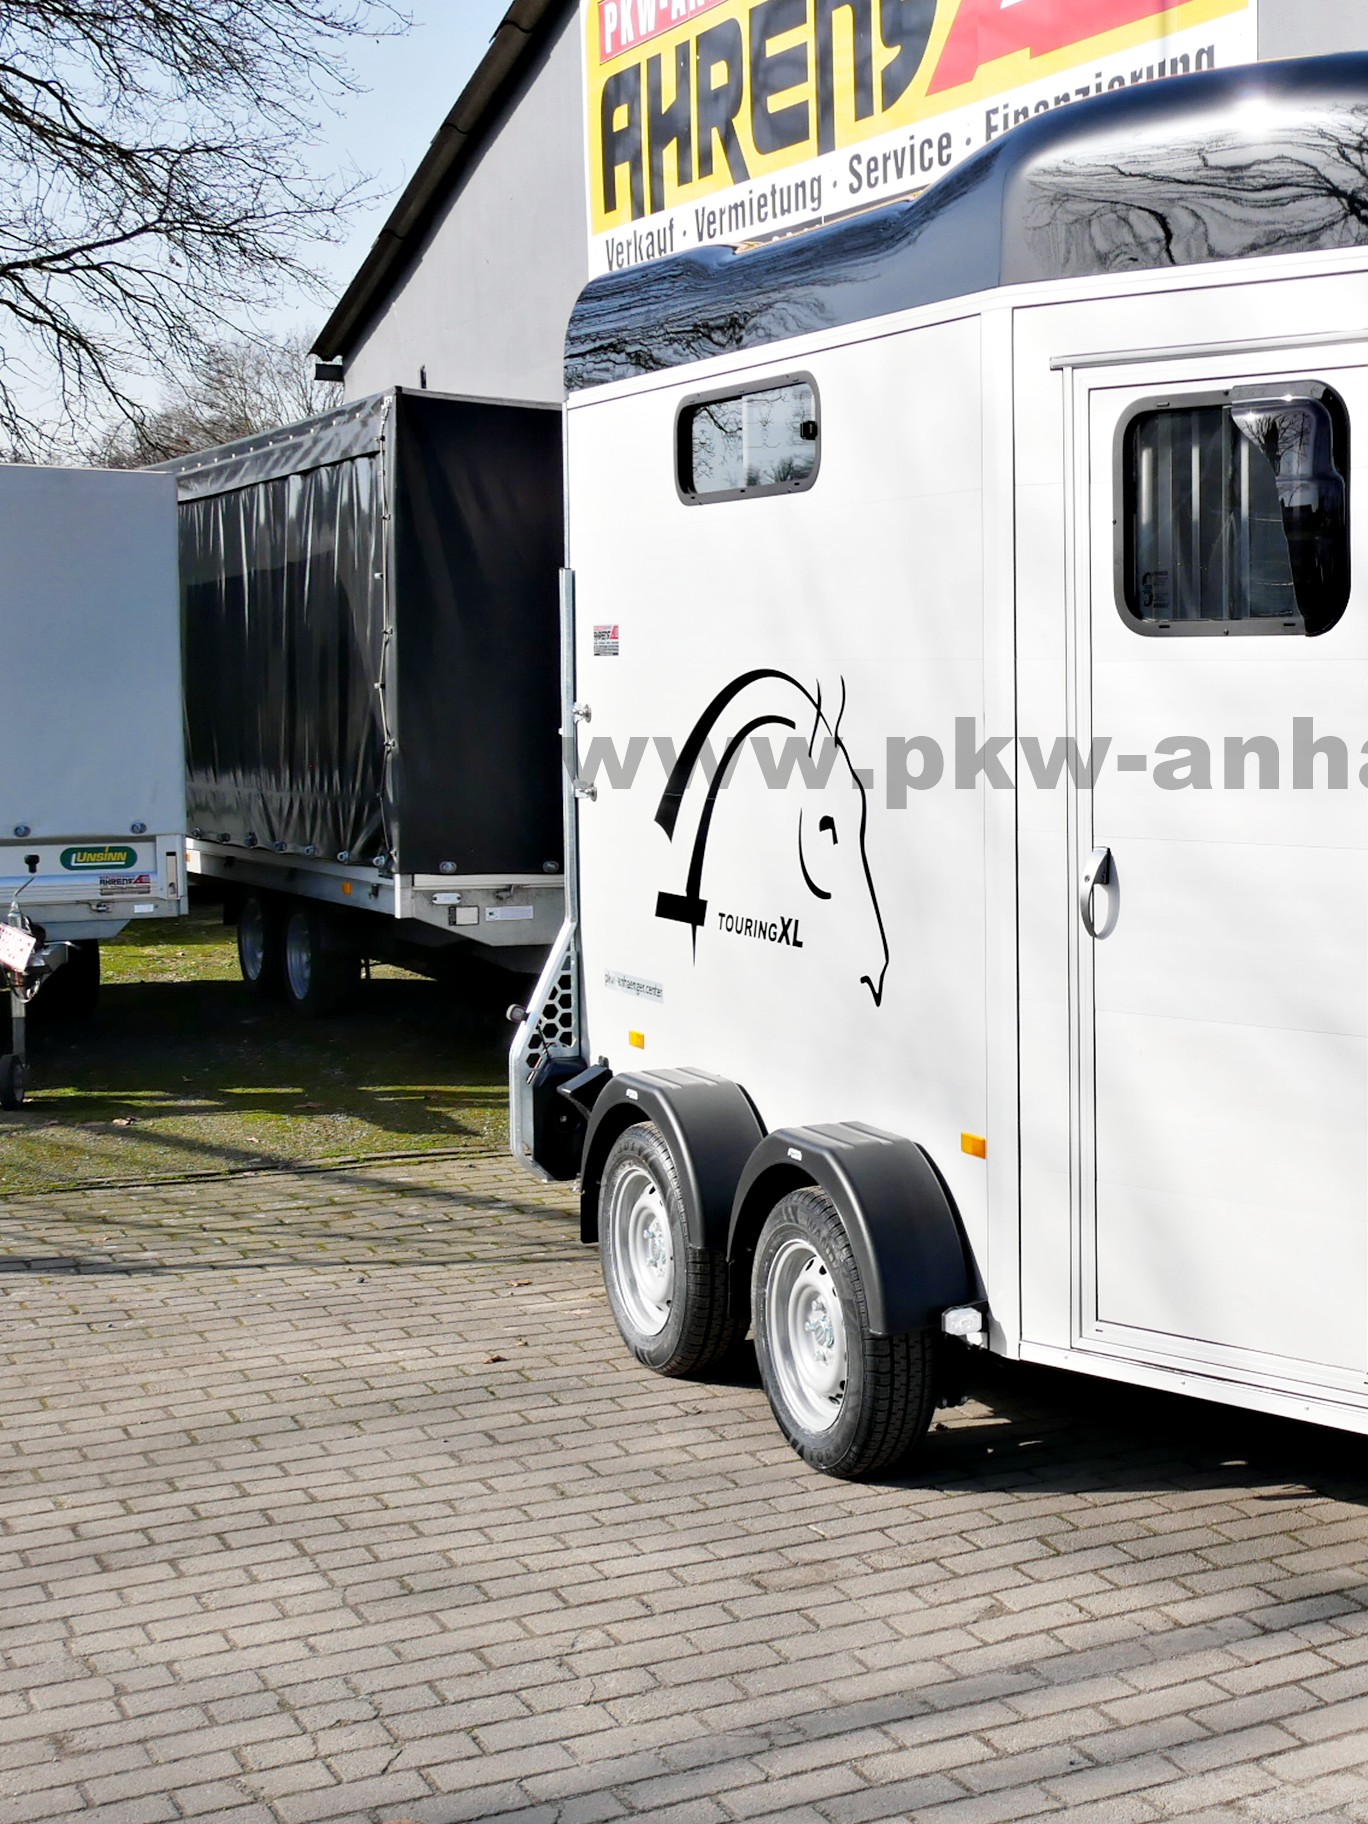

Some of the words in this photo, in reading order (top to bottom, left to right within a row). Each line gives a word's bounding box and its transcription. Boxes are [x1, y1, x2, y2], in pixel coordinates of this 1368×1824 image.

[605, 217, 674, 272] Verkauf
[694, 176, 823, 242] Vermietung
[848, 131, 952, 195] Service
